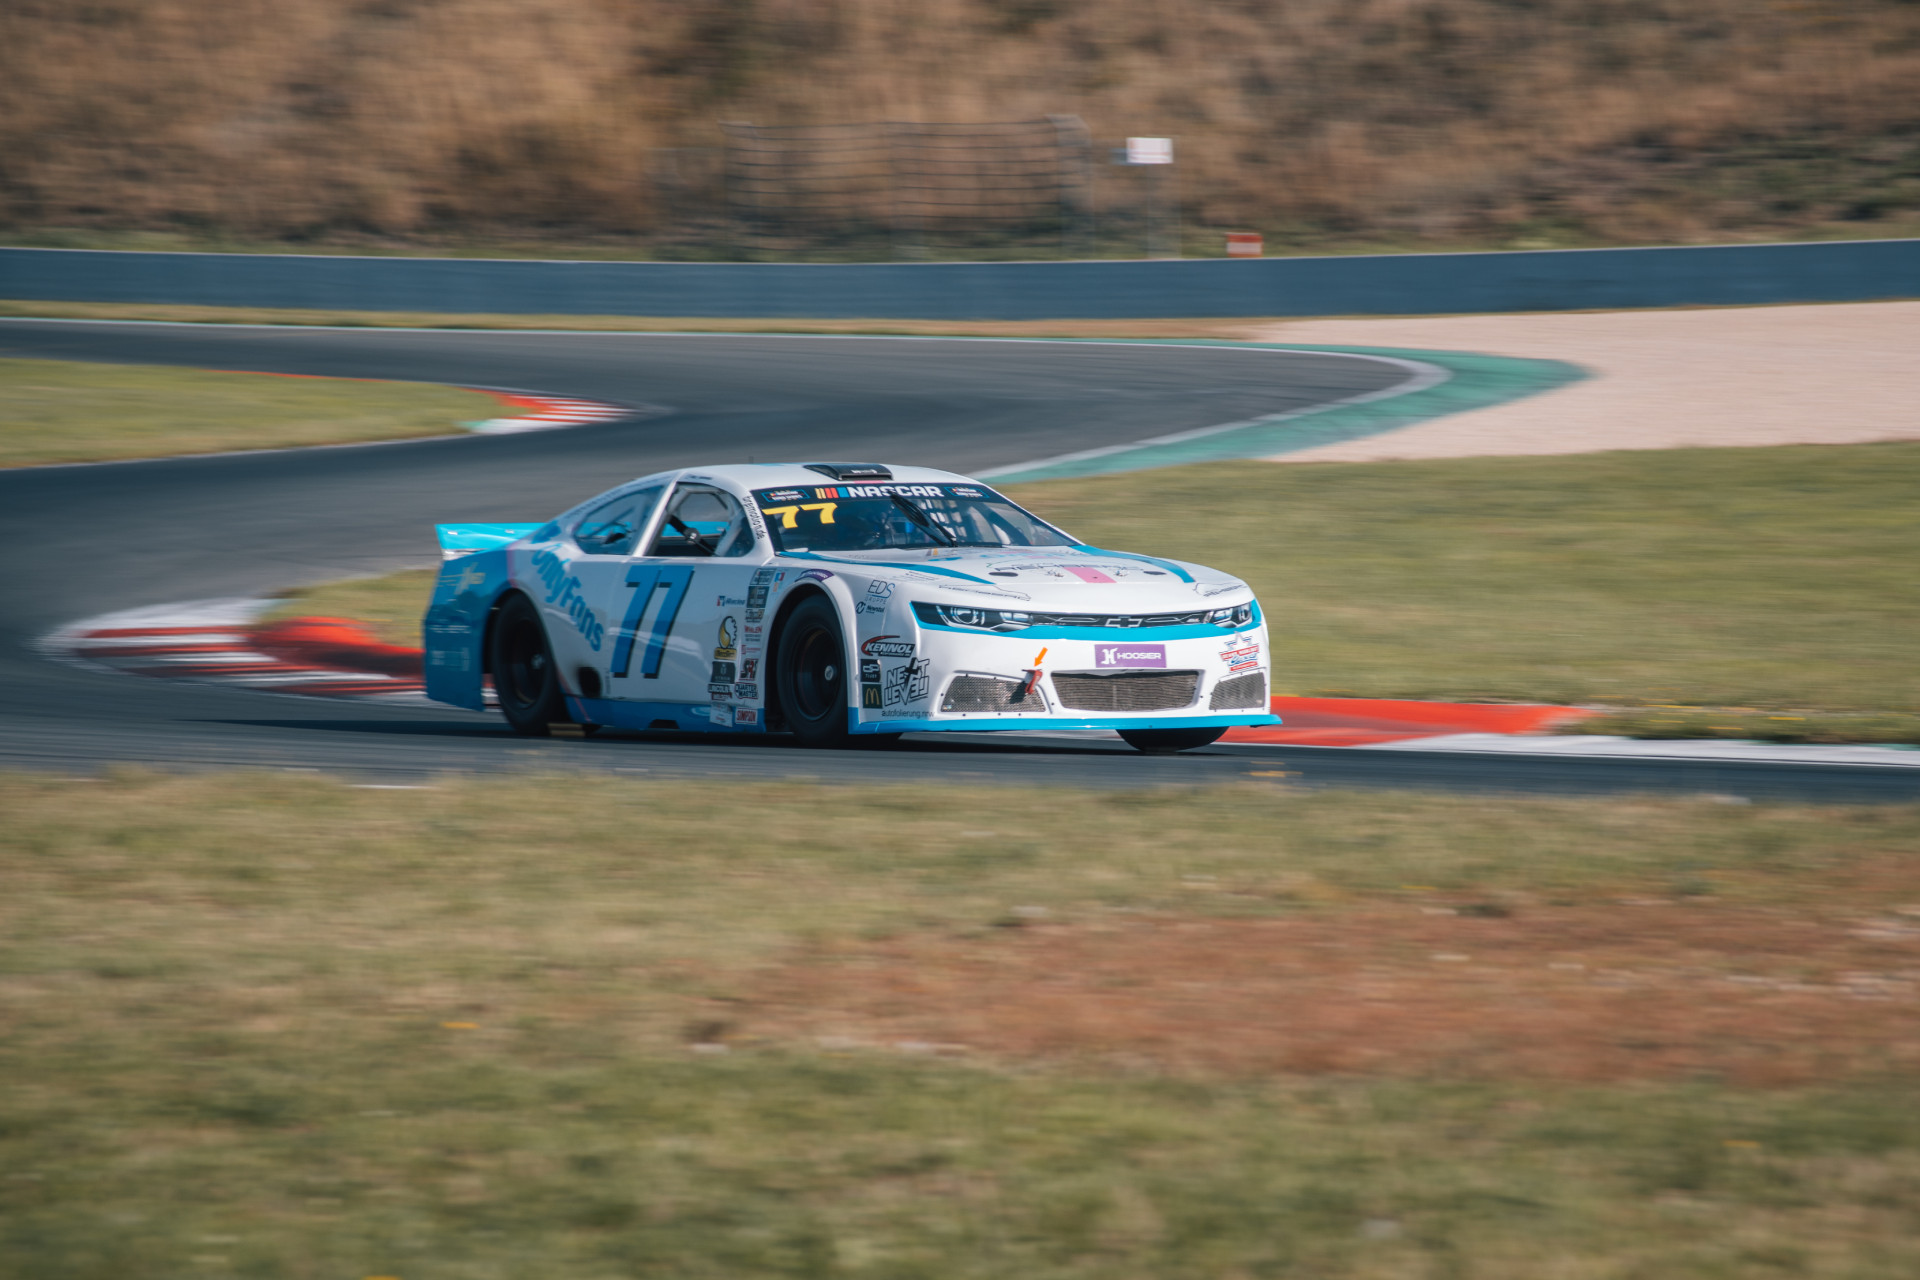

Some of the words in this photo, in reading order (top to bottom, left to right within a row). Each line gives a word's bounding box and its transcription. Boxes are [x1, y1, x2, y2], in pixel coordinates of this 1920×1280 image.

[850, 484, 945, 499] NASCAR
[762, 502, 838, 529] 77
[867, 579, 896, 600] EDS
[610, 564, 695, 679] 77
[865, 642, 913, 654] KENNOL
[1116, 651, 1163, 661] HOOSIER
